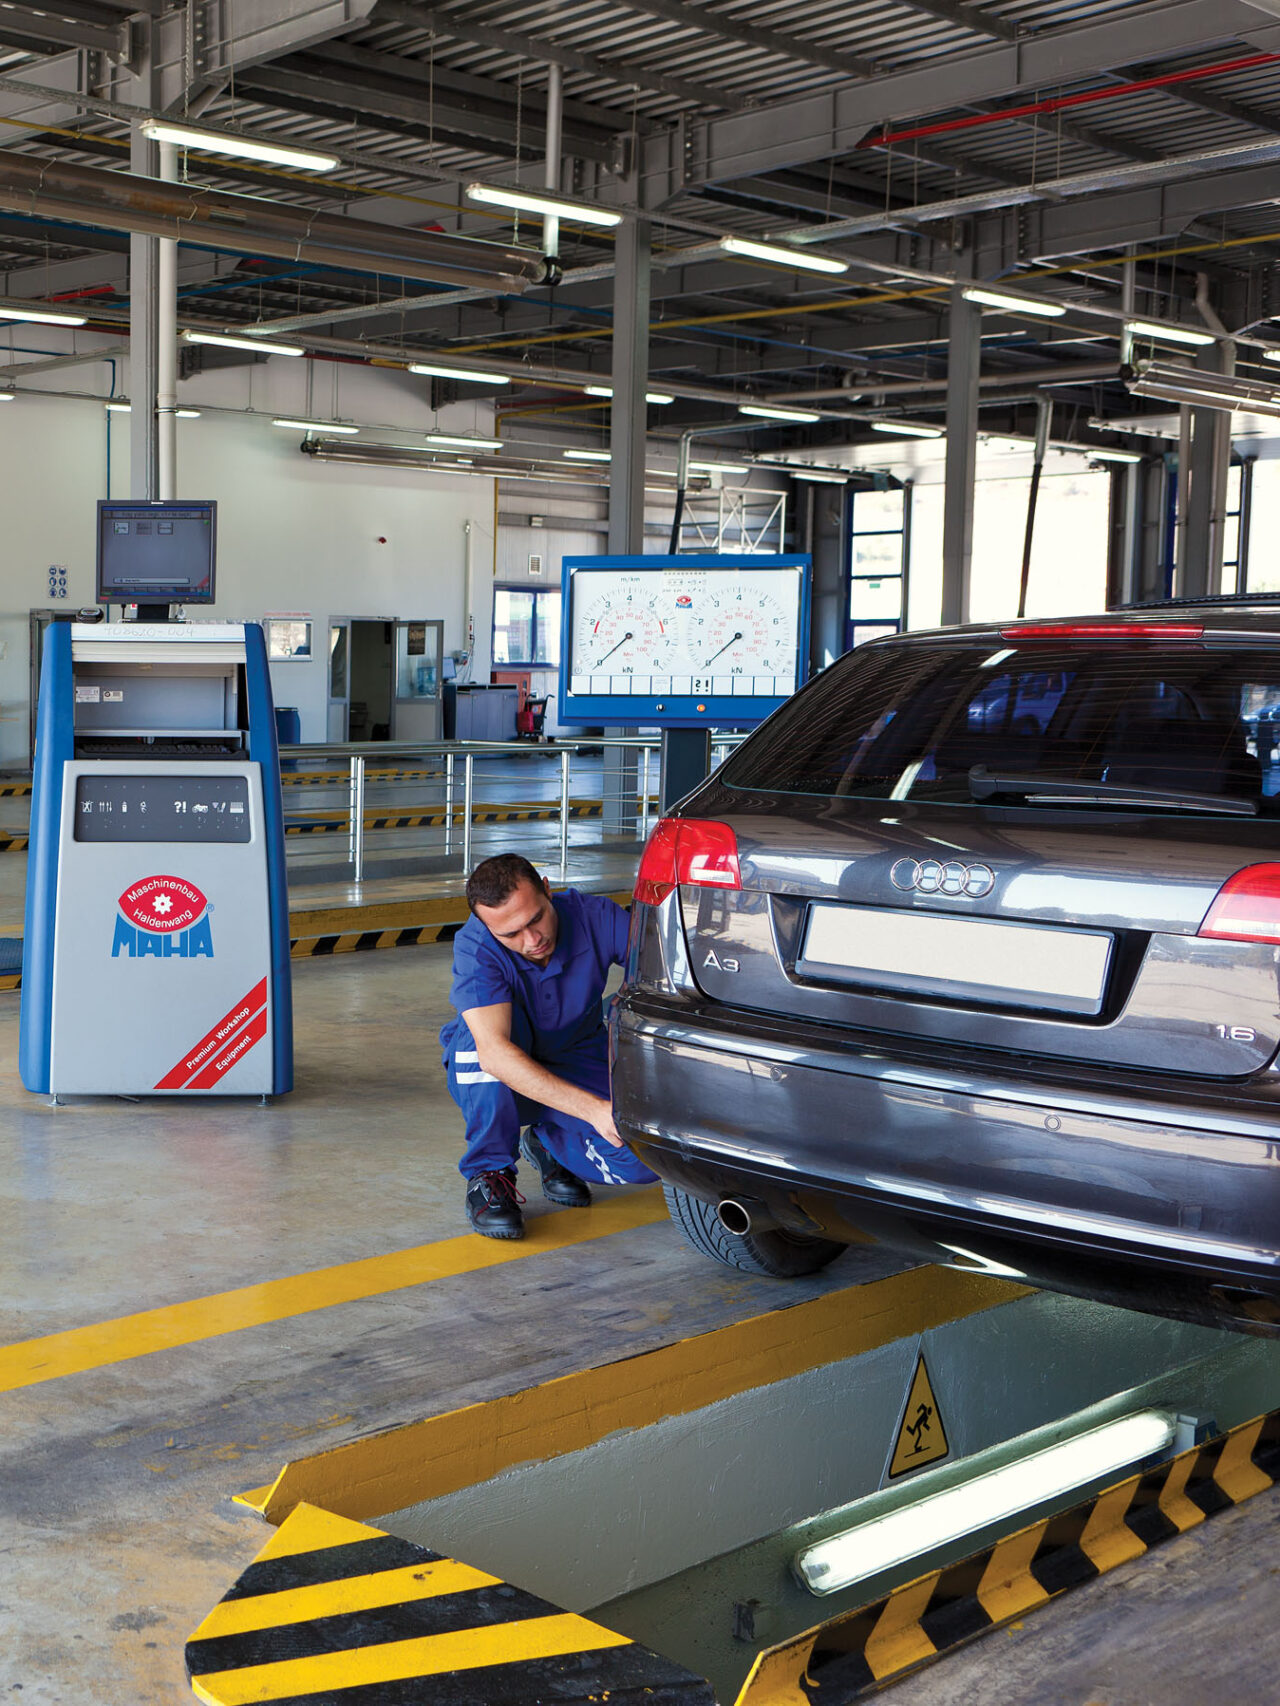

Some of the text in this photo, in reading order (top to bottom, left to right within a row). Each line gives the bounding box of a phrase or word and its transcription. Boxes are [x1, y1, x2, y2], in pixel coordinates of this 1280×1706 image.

[127, 878, 200, 903] Maschinenbau
[133, 908, 193, 928] Haldenwang
[111, 912, 214, 957] MAHA
[703, 949, 740, 972] A3
[186, 1007, 250, 1070] Premium Workshop
[1216, 1024, 1255, 1042] 1.6
[216, 1035, 252, 1070] Equipment
